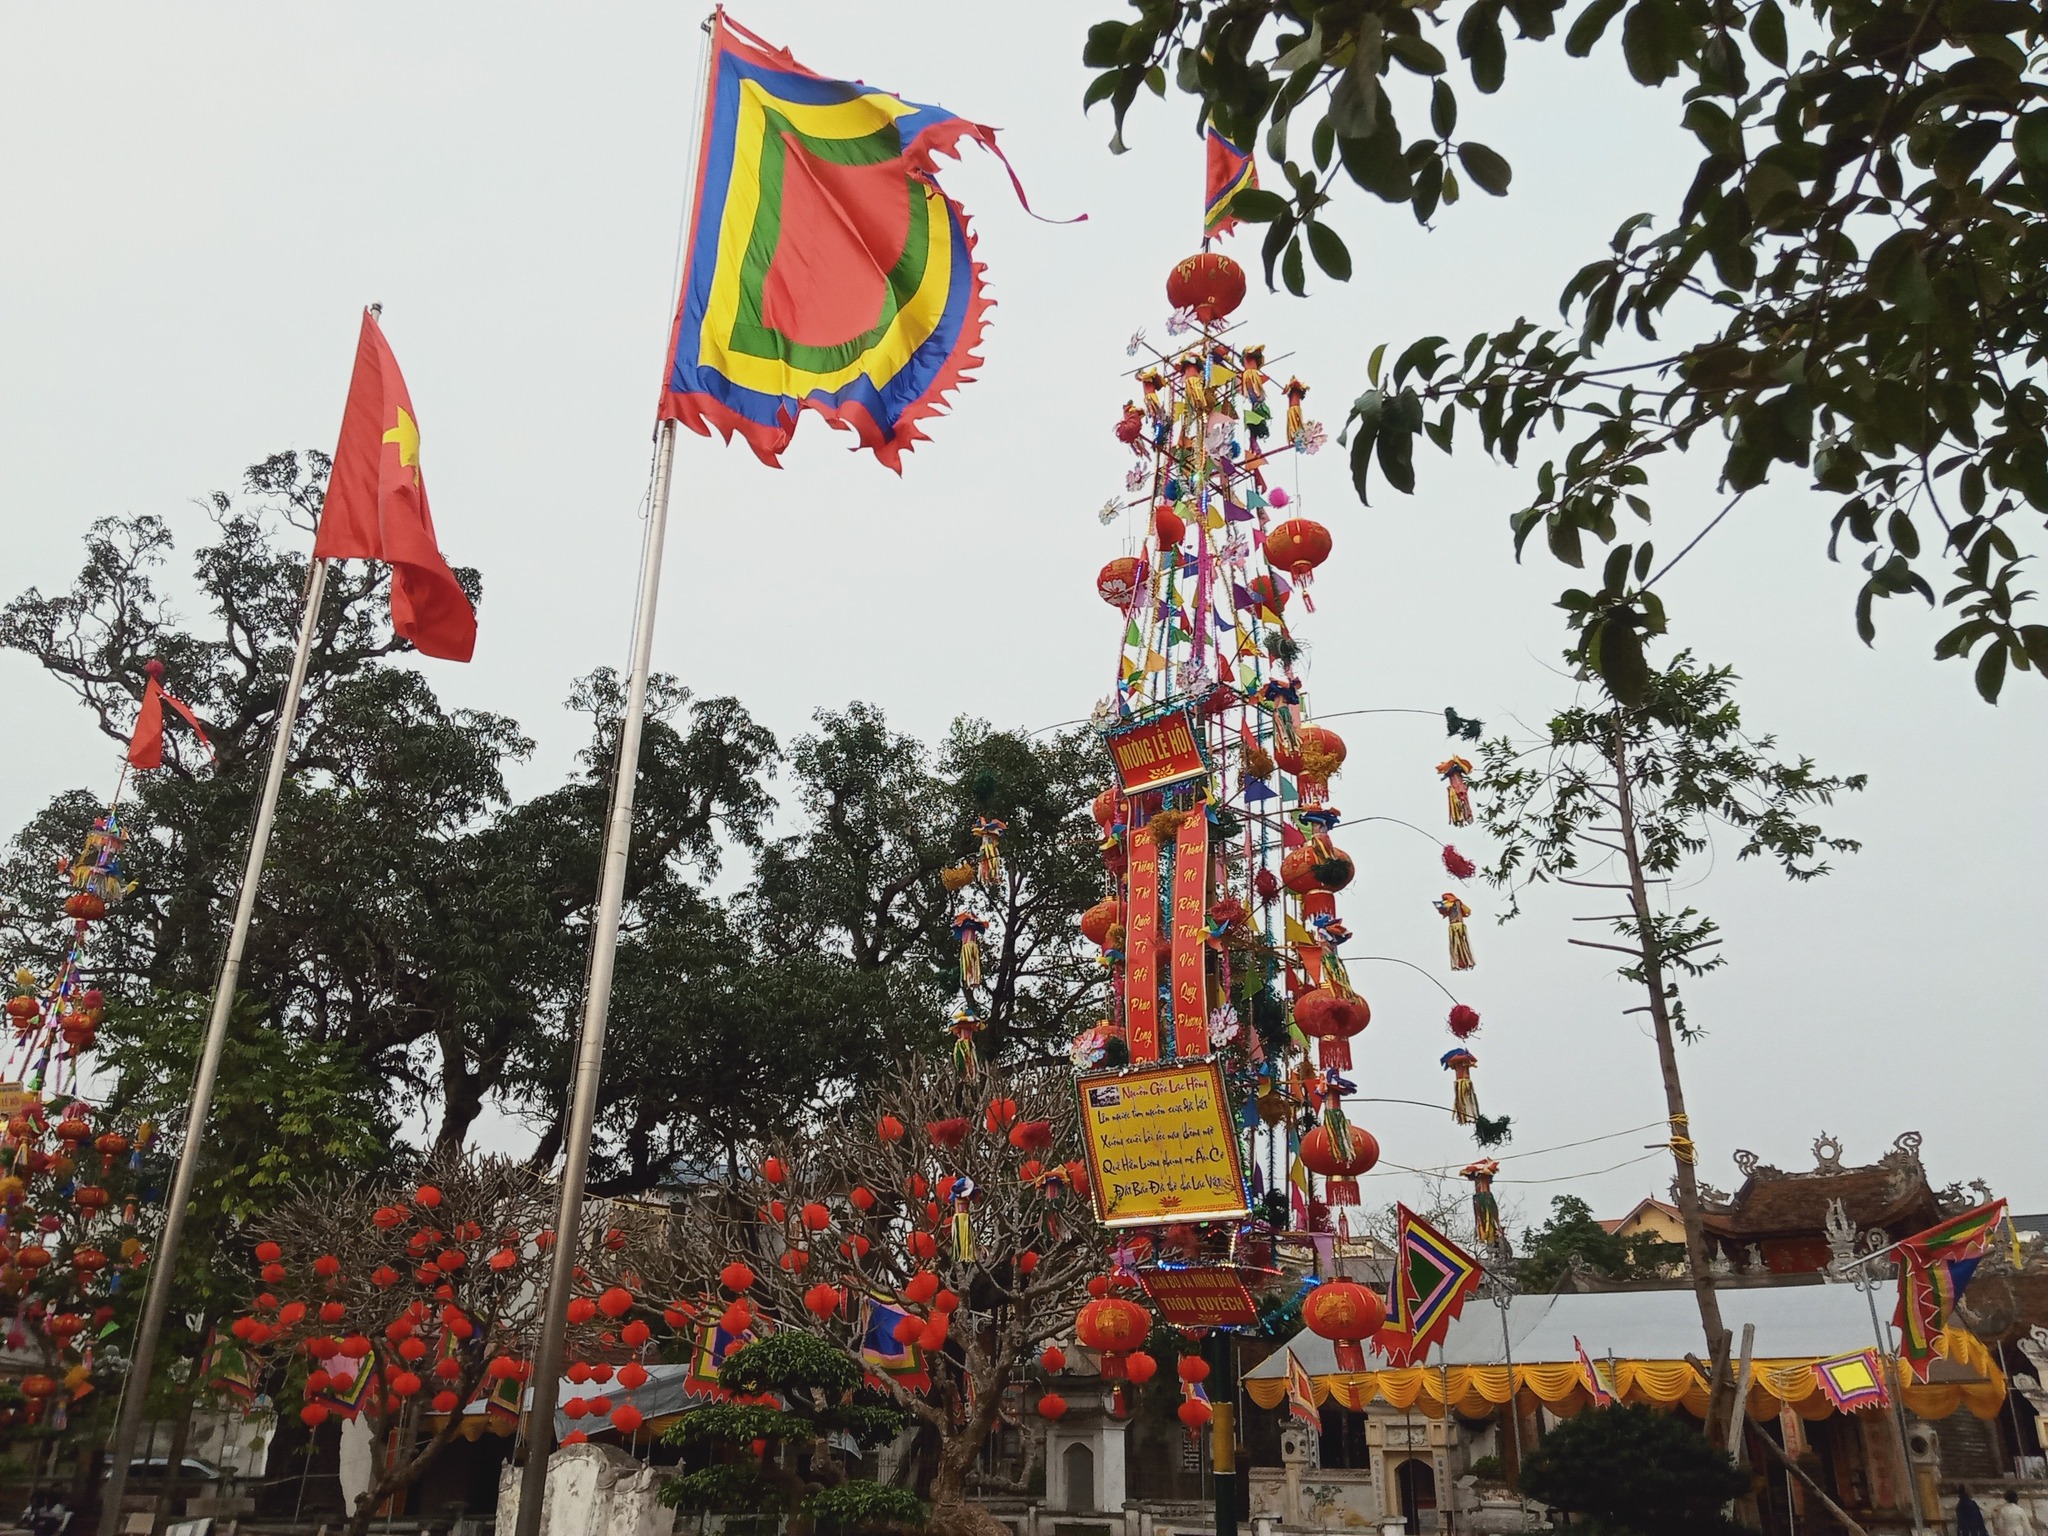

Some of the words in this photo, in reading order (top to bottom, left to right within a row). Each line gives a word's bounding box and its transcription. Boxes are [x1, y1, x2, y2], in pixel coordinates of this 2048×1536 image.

[1117, 737, 1155, 770] MỪNG
[1152, 724, 1171, 760] LỄ
[1167, 722, 1192, 758] HỘI
[1183, 815, 1201, 830] Đất
[1178, 895, 1200, 916] Rồng
[1133, 912, 1152, 931] Quốc
[1135, 937, 1148, 955] Tổ
[1179, 952, 1197, 967] Voi
[1131, 997, 1151, 1015] Phục
[1178, 1013, 1203, 1034] Phượng
[1133, 1027, 1152, 1049] Long
[1150, 1079, 1168, 1096] Gốc
[1185, 1076, 1210, 1099] Hồng
[1161, 1294, 1196, 1311] THÔN
[1195, 1291, 1246, 1312] QUYẾCH
